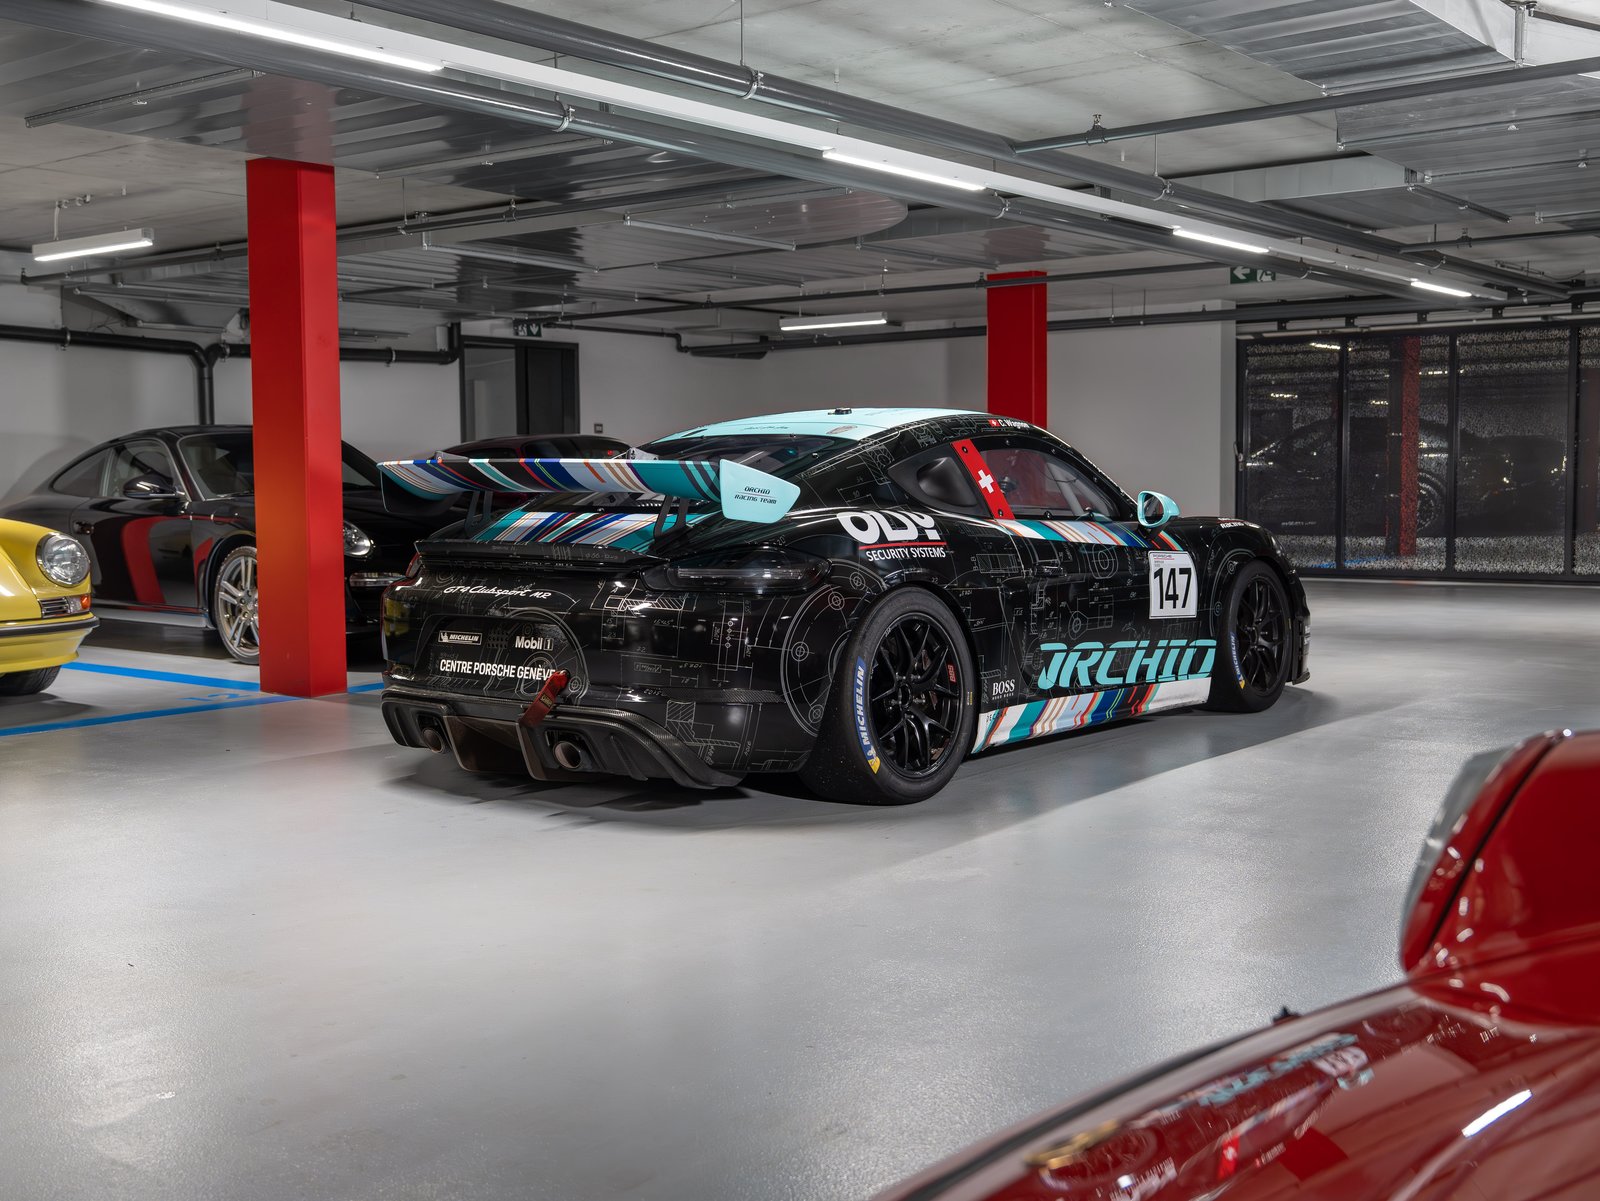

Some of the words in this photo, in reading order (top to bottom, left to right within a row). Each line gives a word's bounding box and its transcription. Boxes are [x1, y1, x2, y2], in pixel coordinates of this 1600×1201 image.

[744, 485, 771, 495] ORCHID
[866, 547, 909, 562] SECURITY
[910, 547, 946, 558] SYSTEMS
[443, 586, 471, 594] GT4
[468, 585, 532, 597] Clubsport
[1153, 567, 1192, 610] 147
[449, 634, 479, 642] MICHELIN
[515, 635, 543, 650] Mobil
[1231, 635, 1241, 675] MICHELIN
[439, 659, 473, 675] CENTRE
[473, 661, 516, 678] PORSCHE
[1037, 639, 1217, 690] ORCHID
[992, 678, 1016, 696] BOSS
[856, 665, 871, 746] MICHELIN
